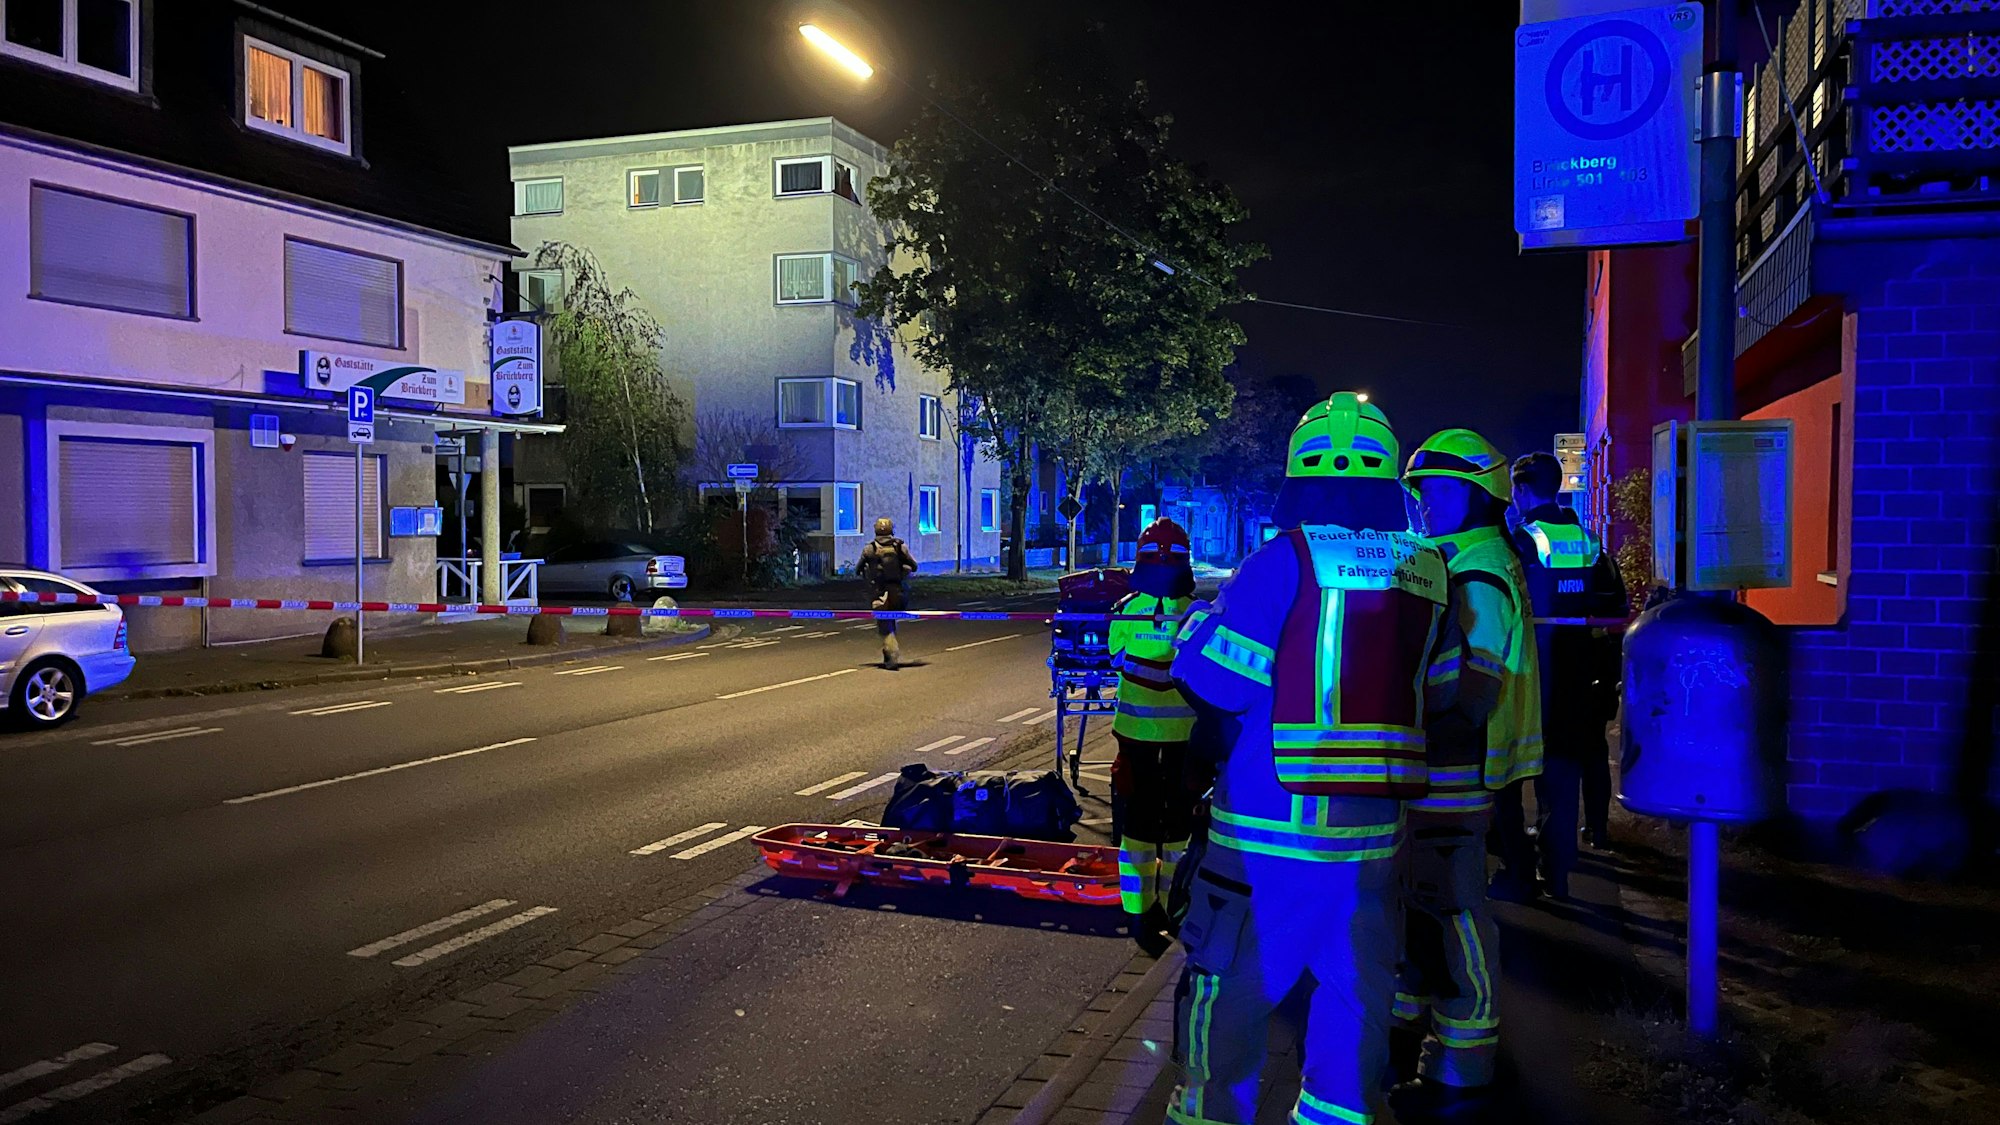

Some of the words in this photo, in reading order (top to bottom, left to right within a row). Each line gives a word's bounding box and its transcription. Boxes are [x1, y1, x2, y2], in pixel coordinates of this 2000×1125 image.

[1668, 11, 1689, 21] VRS
[1581, 44, 1632, 116] H
[1532, 156, 1617, 173] Brckberg
[1576, 172, 1603, 187] 501
[496, 345, 533, 355] Gaststätte
[334, 357, 374, 371] Gaststätte
[517, 361, 534, 370] Zum
[421, 373, 437, 385] Zum
[496, 371, 534, 382] Brückberg
[401, 382, 437, 398] Brückberg
[354, 391, 369, 418] P
[1308, 530, 1389, 542] Feuerwehr
[1356, 546, 1387, 559] BRB
[1337, 565, 1433, 589] Fahrzeugführer
[1558, 579, 1585, 592] NRW
